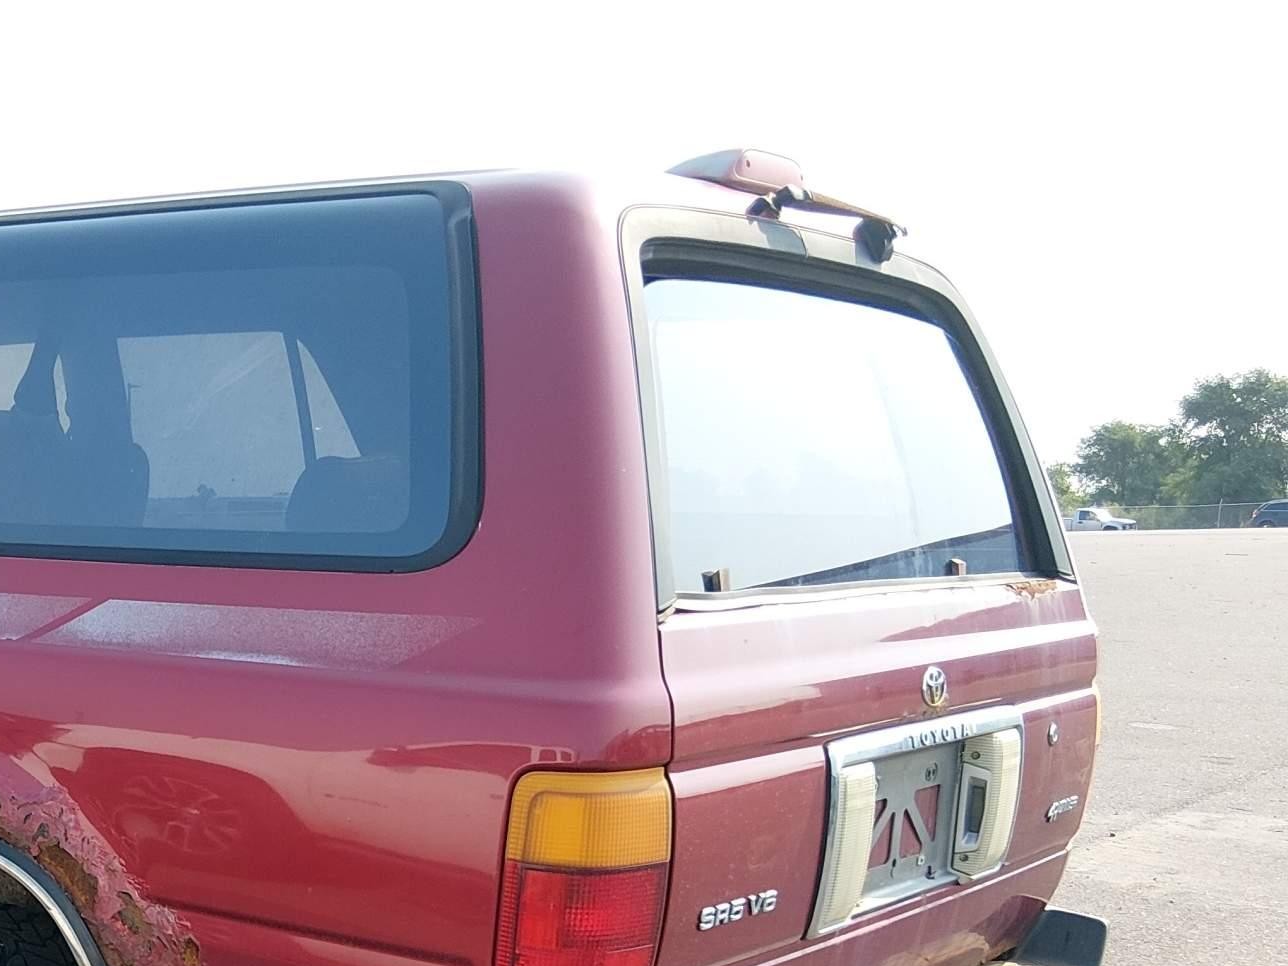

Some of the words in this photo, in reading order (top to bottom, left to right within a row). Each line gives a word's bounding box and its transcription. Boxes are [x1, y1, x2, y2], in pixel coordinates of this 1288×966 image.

[906, 723, 975, 749] TOYOTA
[698, 897, 746, 931] SR5
[748, 889, 778, 915] V6
